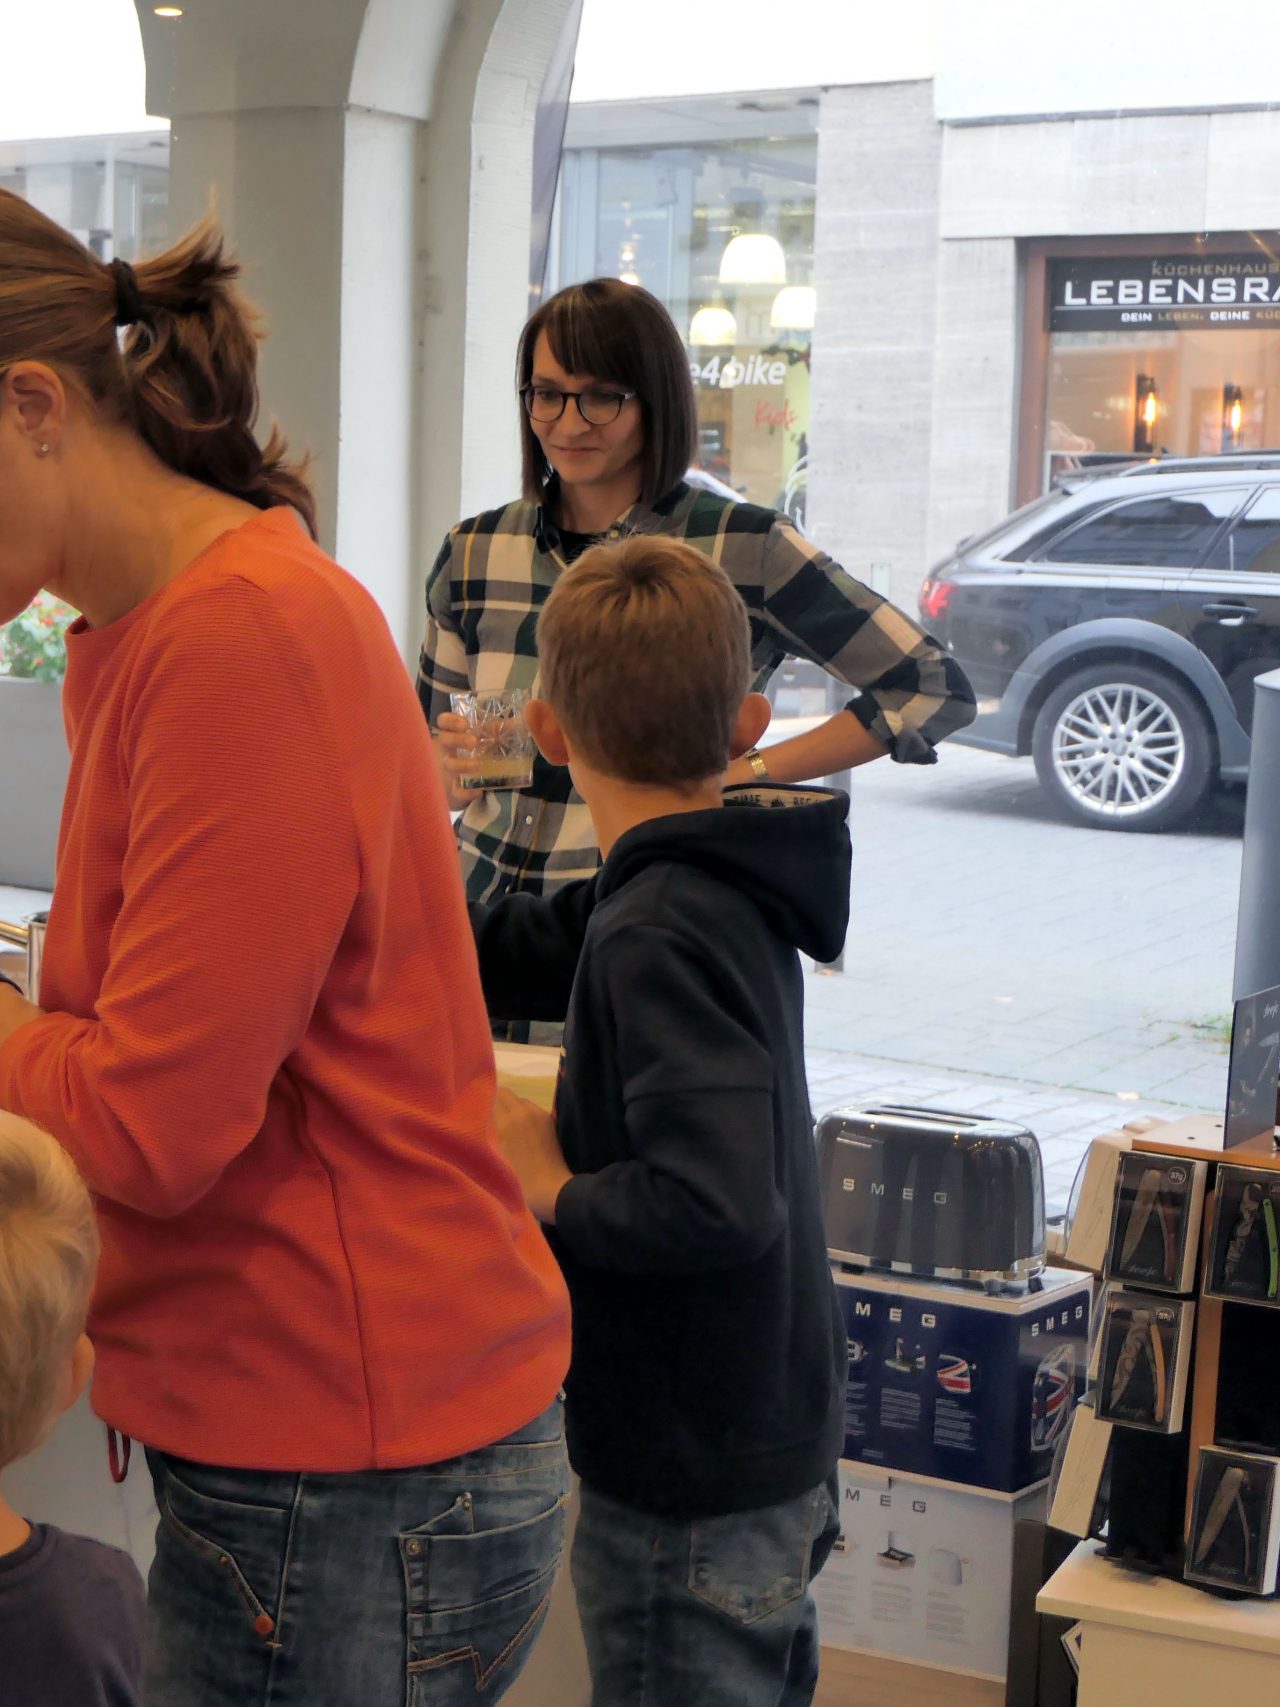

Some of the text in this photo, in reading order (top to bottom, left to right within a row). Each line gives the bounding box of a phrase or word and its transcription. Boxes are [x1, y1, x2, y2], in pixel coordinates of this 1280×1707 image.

[1064, 276, 1280, 306] LEBENSR
[842, 1177, 948, 1205] SMEG
[1031, 1304, 1083, 1338] SMEG
